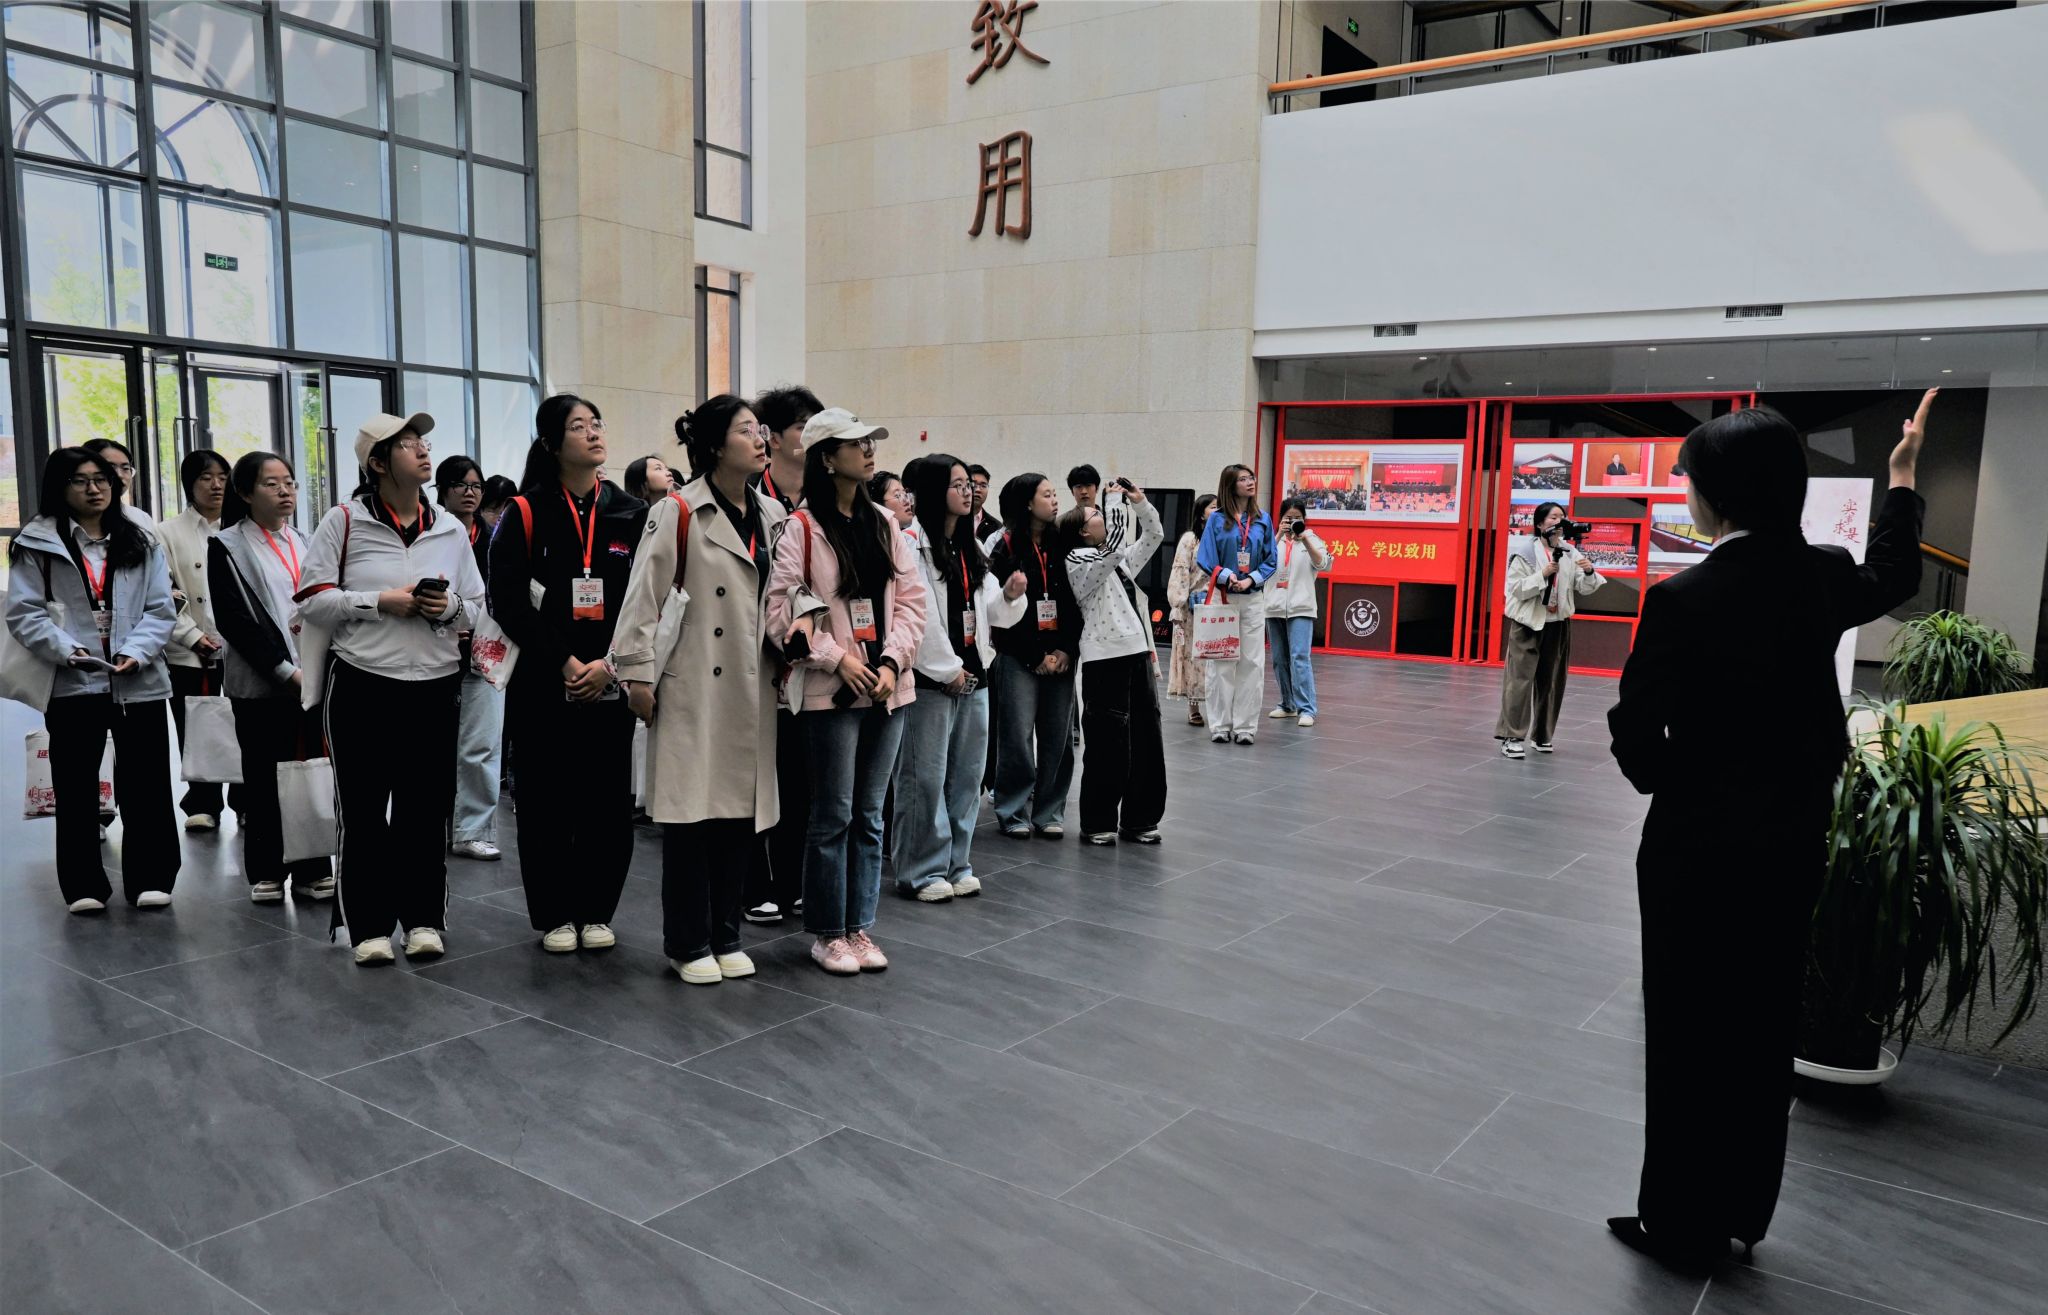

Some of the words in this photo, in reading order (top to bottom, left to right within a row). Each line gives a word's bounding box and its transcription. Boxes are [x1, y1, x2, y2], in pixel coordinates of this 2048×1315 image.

[1323, 540, 1360, 557] 为公
[1371, 541, 1437, 560] 学以致用
